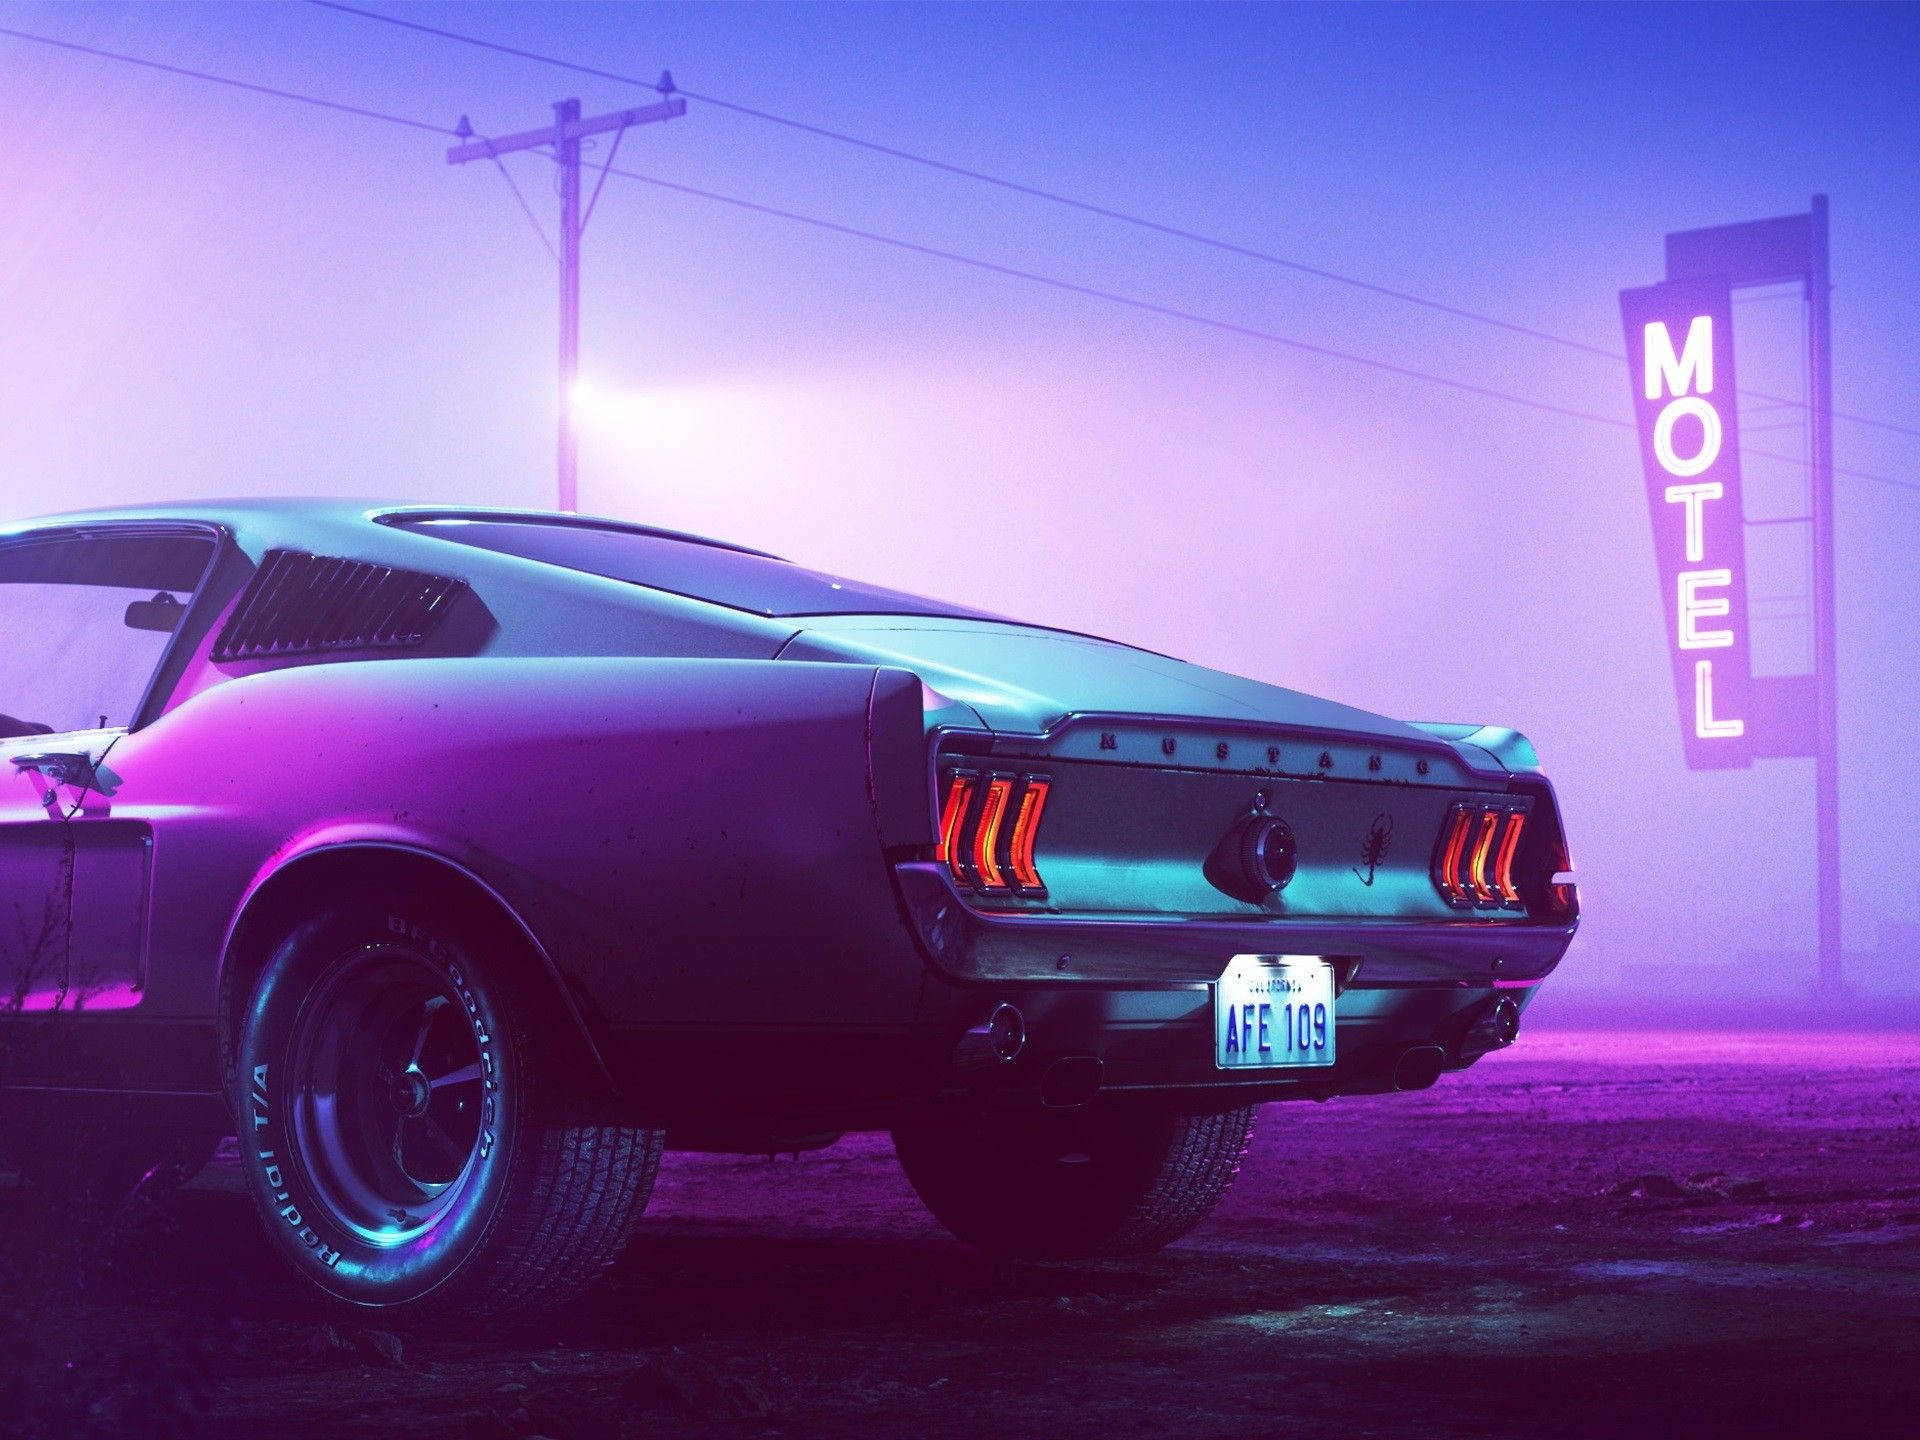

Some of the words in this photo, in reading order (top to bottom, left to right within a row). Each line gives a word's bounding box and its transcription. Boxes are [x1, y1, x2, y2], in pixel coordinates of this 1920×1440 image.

[1643, 315, 1744, 738] MOTEL
[1100, 733, 1430, 776] MUSTANG
[1225, 1003, 1271, 1053] AFE
[1285, 1002, 1327, 1051] 109
[252, 1063, 270, 1132] T/A
[259, 1150, 343, 1271] Radial
